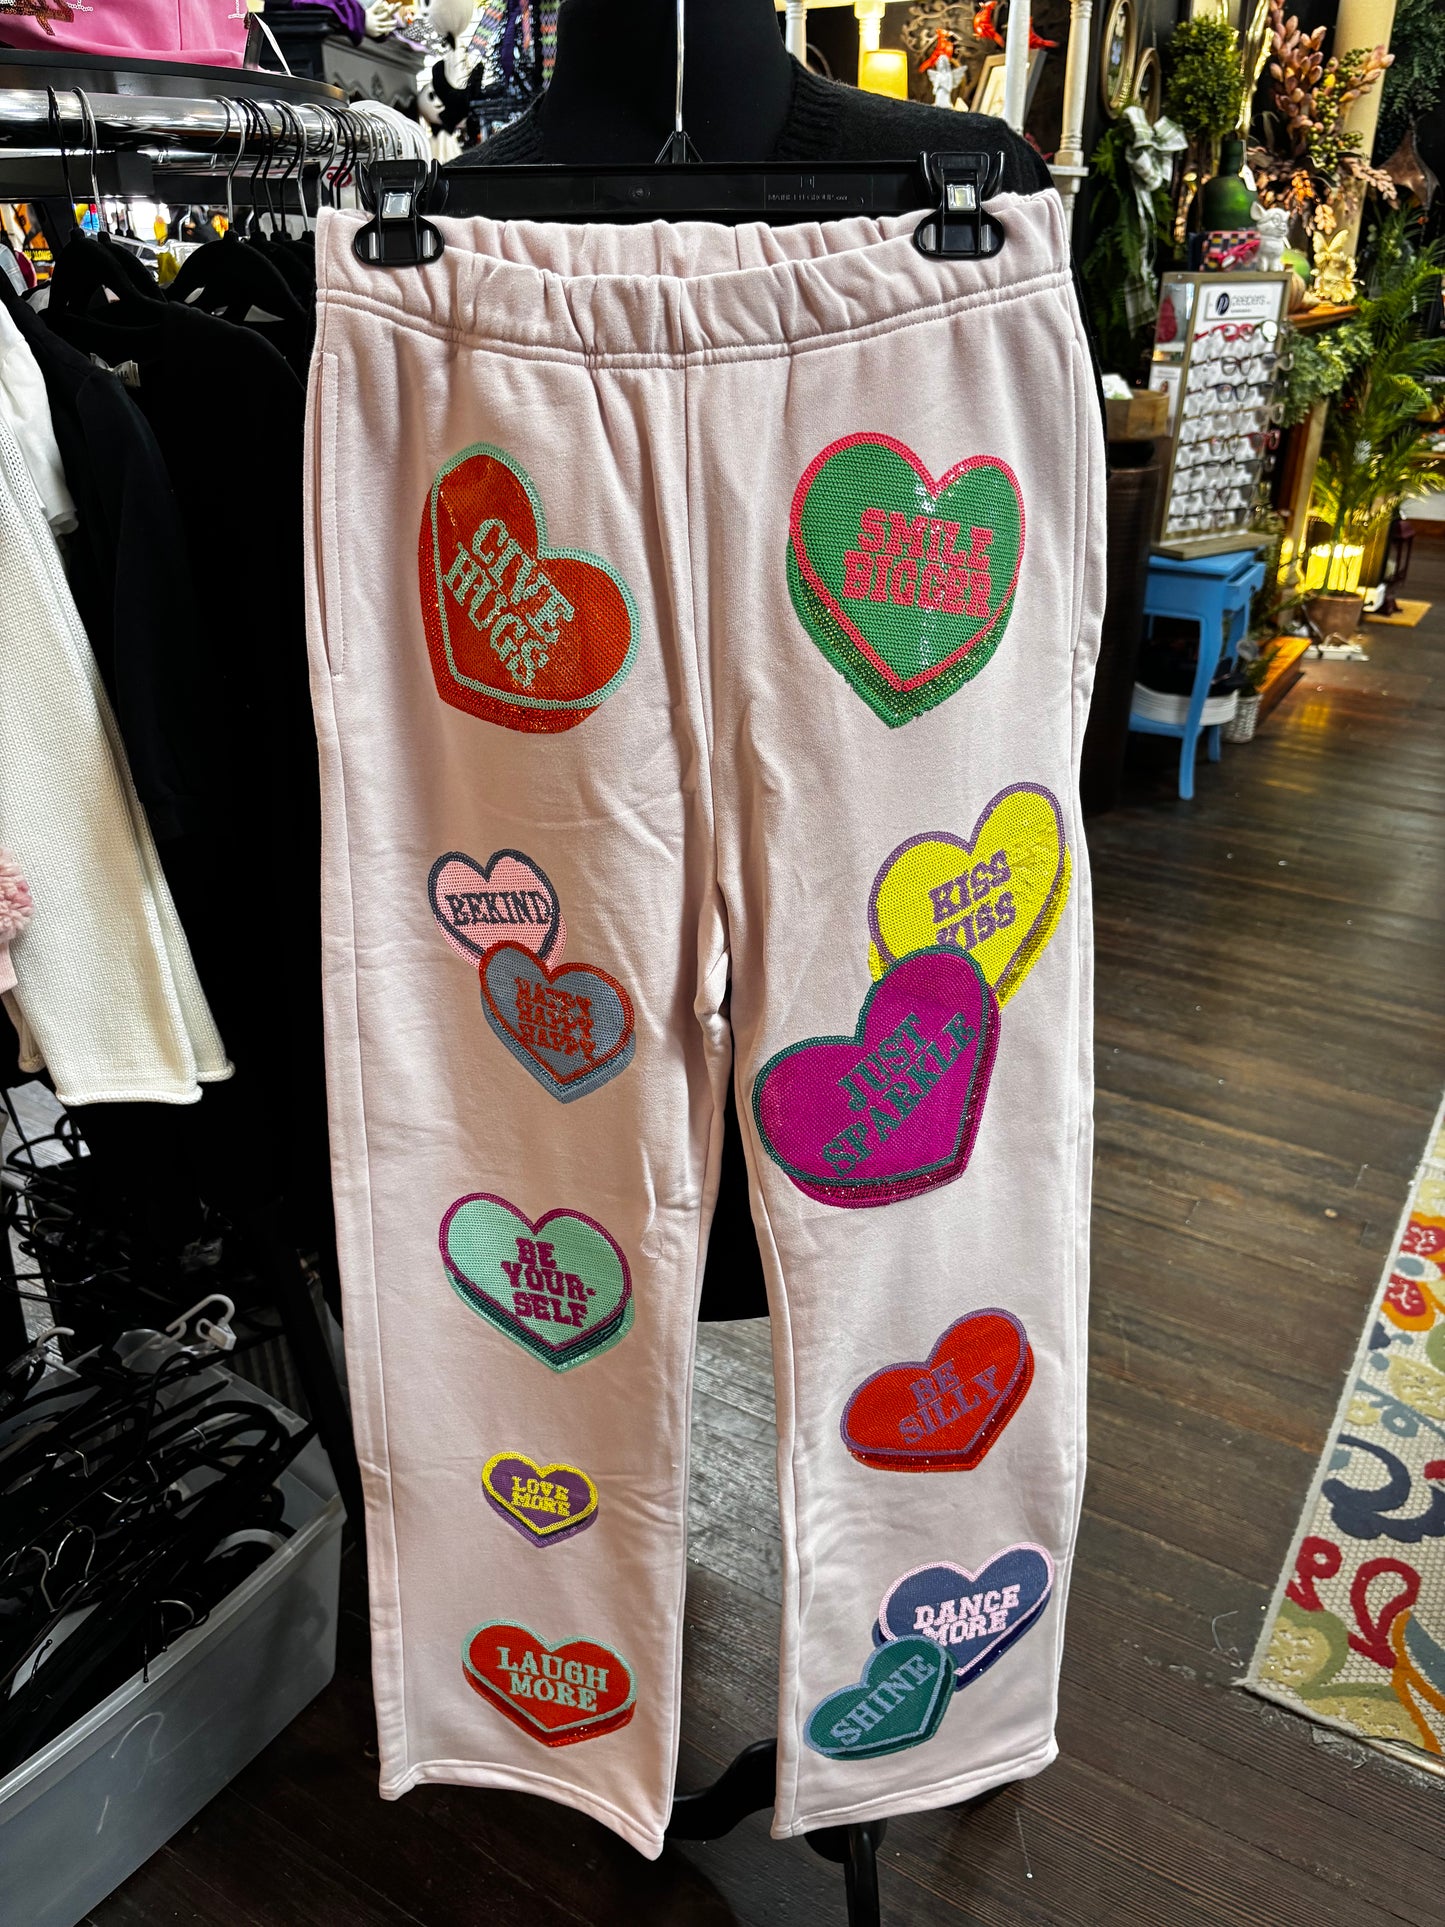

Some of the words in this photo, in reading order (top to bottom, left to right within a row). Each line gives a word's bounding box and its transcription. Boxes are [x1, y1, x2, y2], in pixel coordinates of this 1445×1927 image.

[857, 507, 993, 571] SMILE
[472, 518, 574, 644] GIVE
[842, 550, 992, 618] BIGGER
[443, 542, 549, 687] HUGS
[928, 849, 1013, 924] KISS
[517, 1022, 596, 1061] HAPPY
[838, 1012, 932, 1112] JUST
[822, 1011, 975, 1177] SPARKLE
[515, 1237, 557, 1269] BE
[512, 1291, 588, 1328] SELF
[898, 1365, 1000, 1444] SILLY
[910, 1358, 960, 1408] BE
[511, 1475, 569, 1501] LOVE
[511, 1491, 571, 1517] MORE
[913, 1584, 1021, 1630] DANCE
[922, 1609, 1009, 1646] MORE
[496, 1646, 609, 1693] LAUGH
[509, 1671, 598, 1712] MORE
[830, 1654, 937, 1746] SHINE
